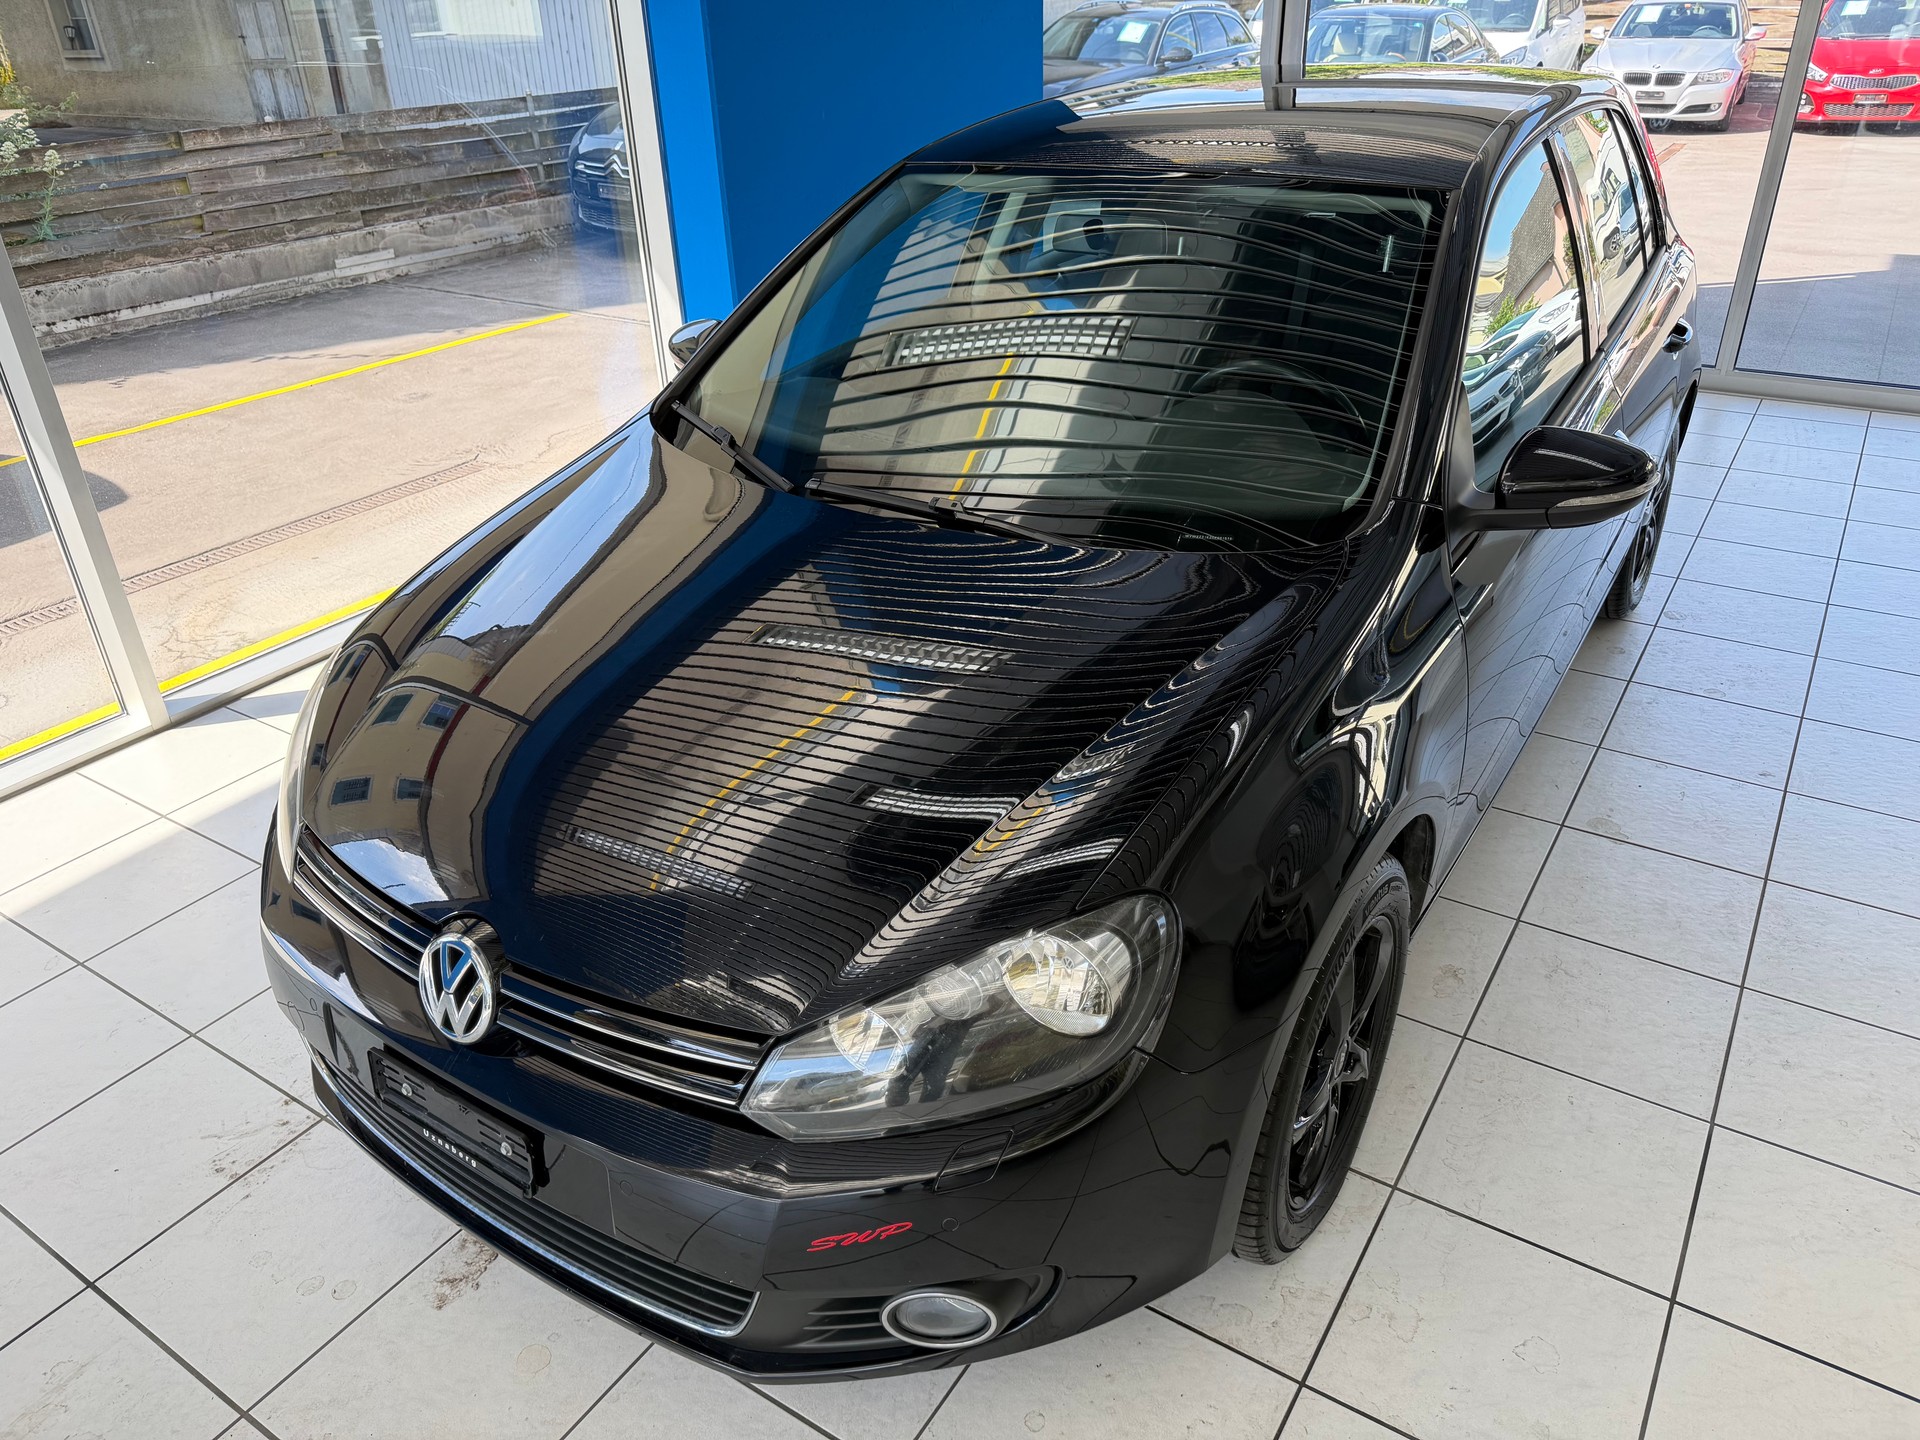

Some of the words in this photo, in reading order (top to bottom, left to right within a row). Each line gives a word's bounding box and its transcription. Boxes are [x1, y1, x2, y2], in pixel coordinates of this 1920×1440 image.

[422, 935, 491, 1043] VW
[422, 1128, 477, 1168] Uznaberg
[806, 1221, 913, 1252] SWP
